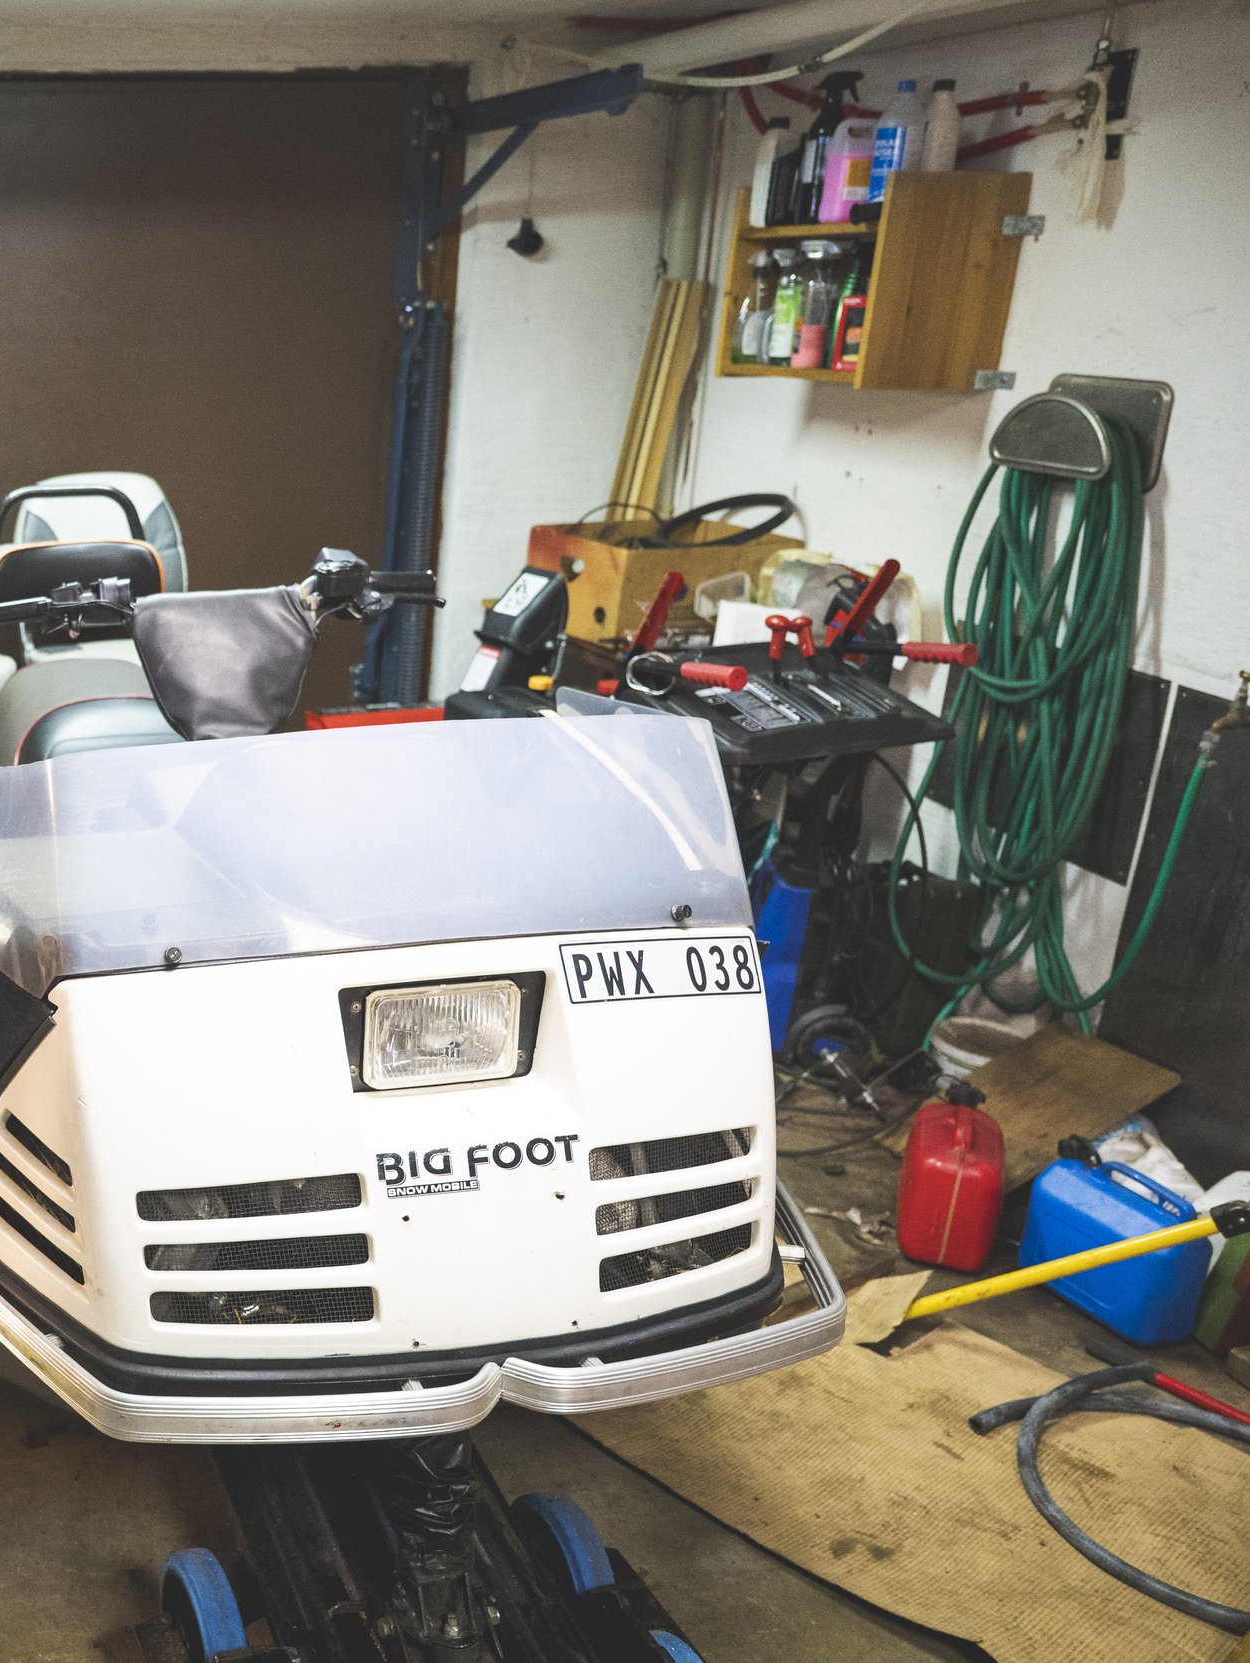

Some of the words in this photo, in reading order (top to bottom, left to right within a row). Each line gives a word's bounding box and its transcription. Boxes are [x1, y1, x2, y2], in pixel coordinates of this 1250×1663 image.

[571, 950, 655, 999] PWX
[685, 944, 754, 993] 038
[375, 1148, 452, 1186] BIG
[467, 1134, 580, 1178] FOOT
[387, 1185, 428, 1197] SNOW
[430, 1180, 479, 1193] MOBILE
